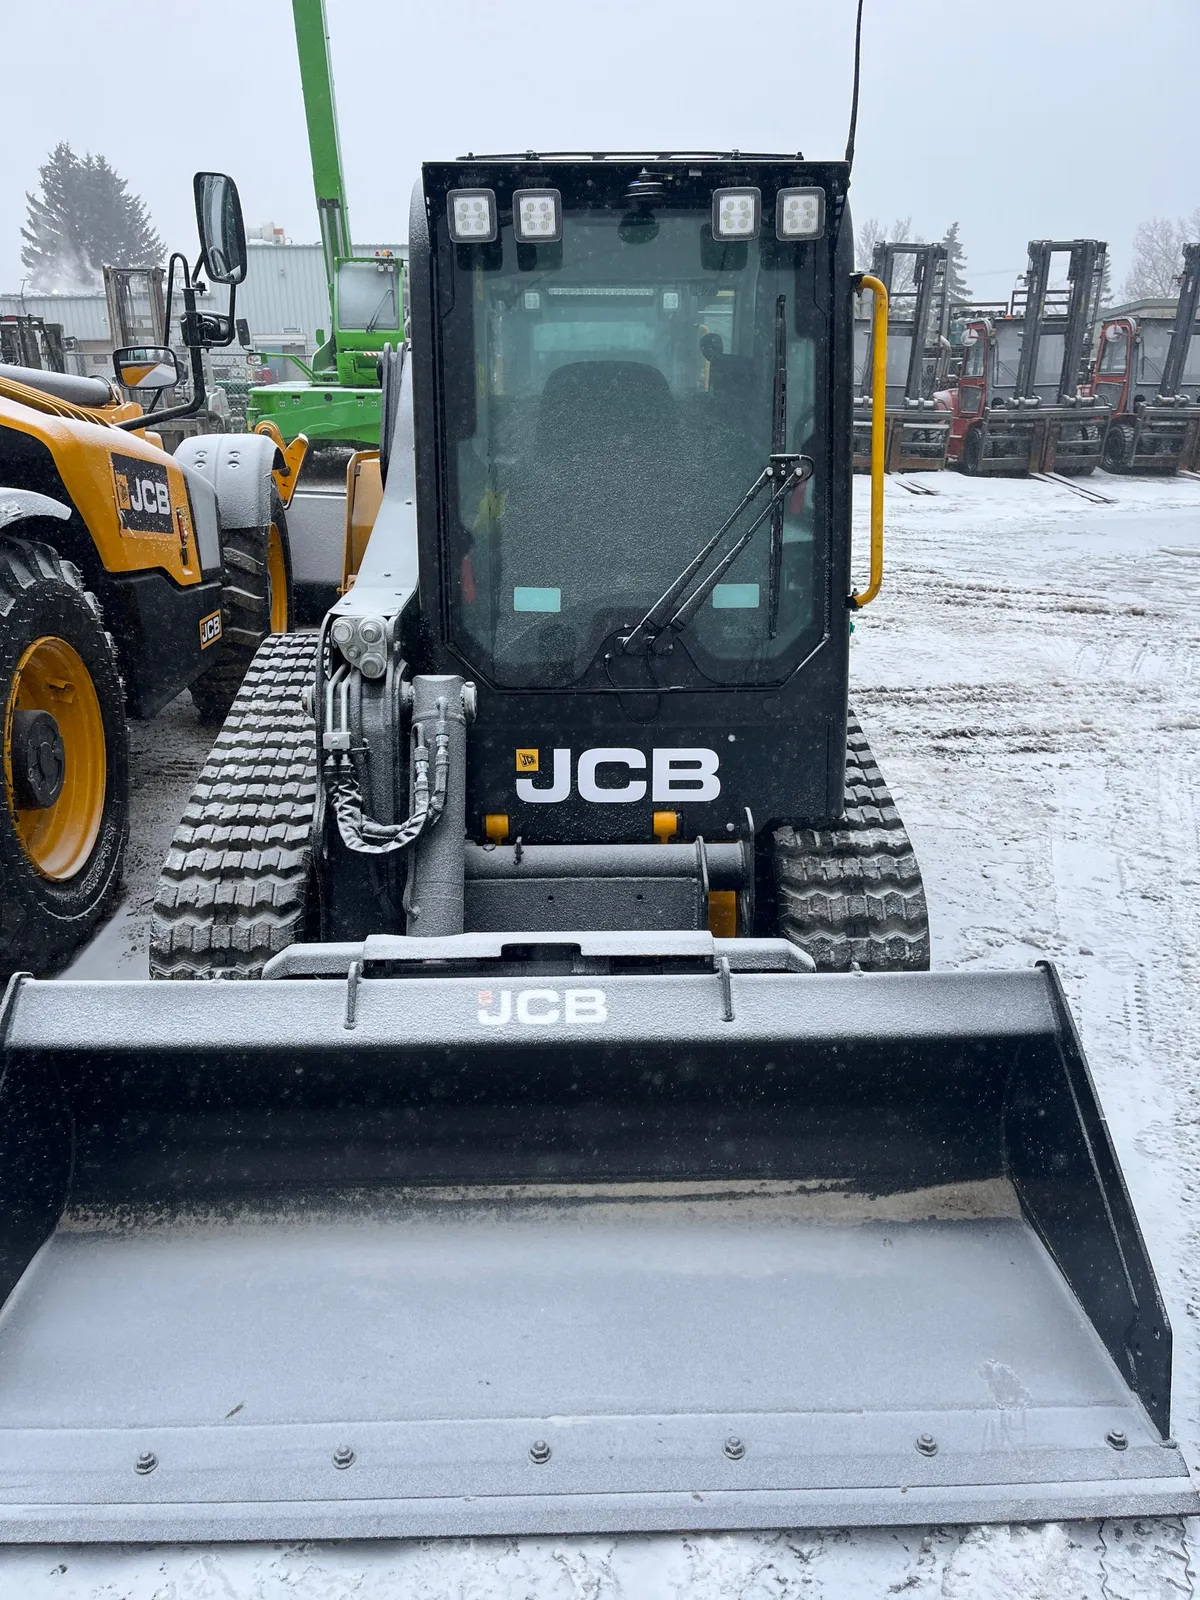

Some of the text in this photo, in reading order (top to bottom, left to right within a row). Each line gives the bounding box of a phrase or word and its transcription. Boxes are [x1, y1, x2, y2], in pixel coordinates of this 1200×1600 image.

[131, 477, 171, 516] JCB
[202, 616, 220, 643] JCB
[516, 748, 721, 803] JCB
[478, 988, 607, 1025] JCB
